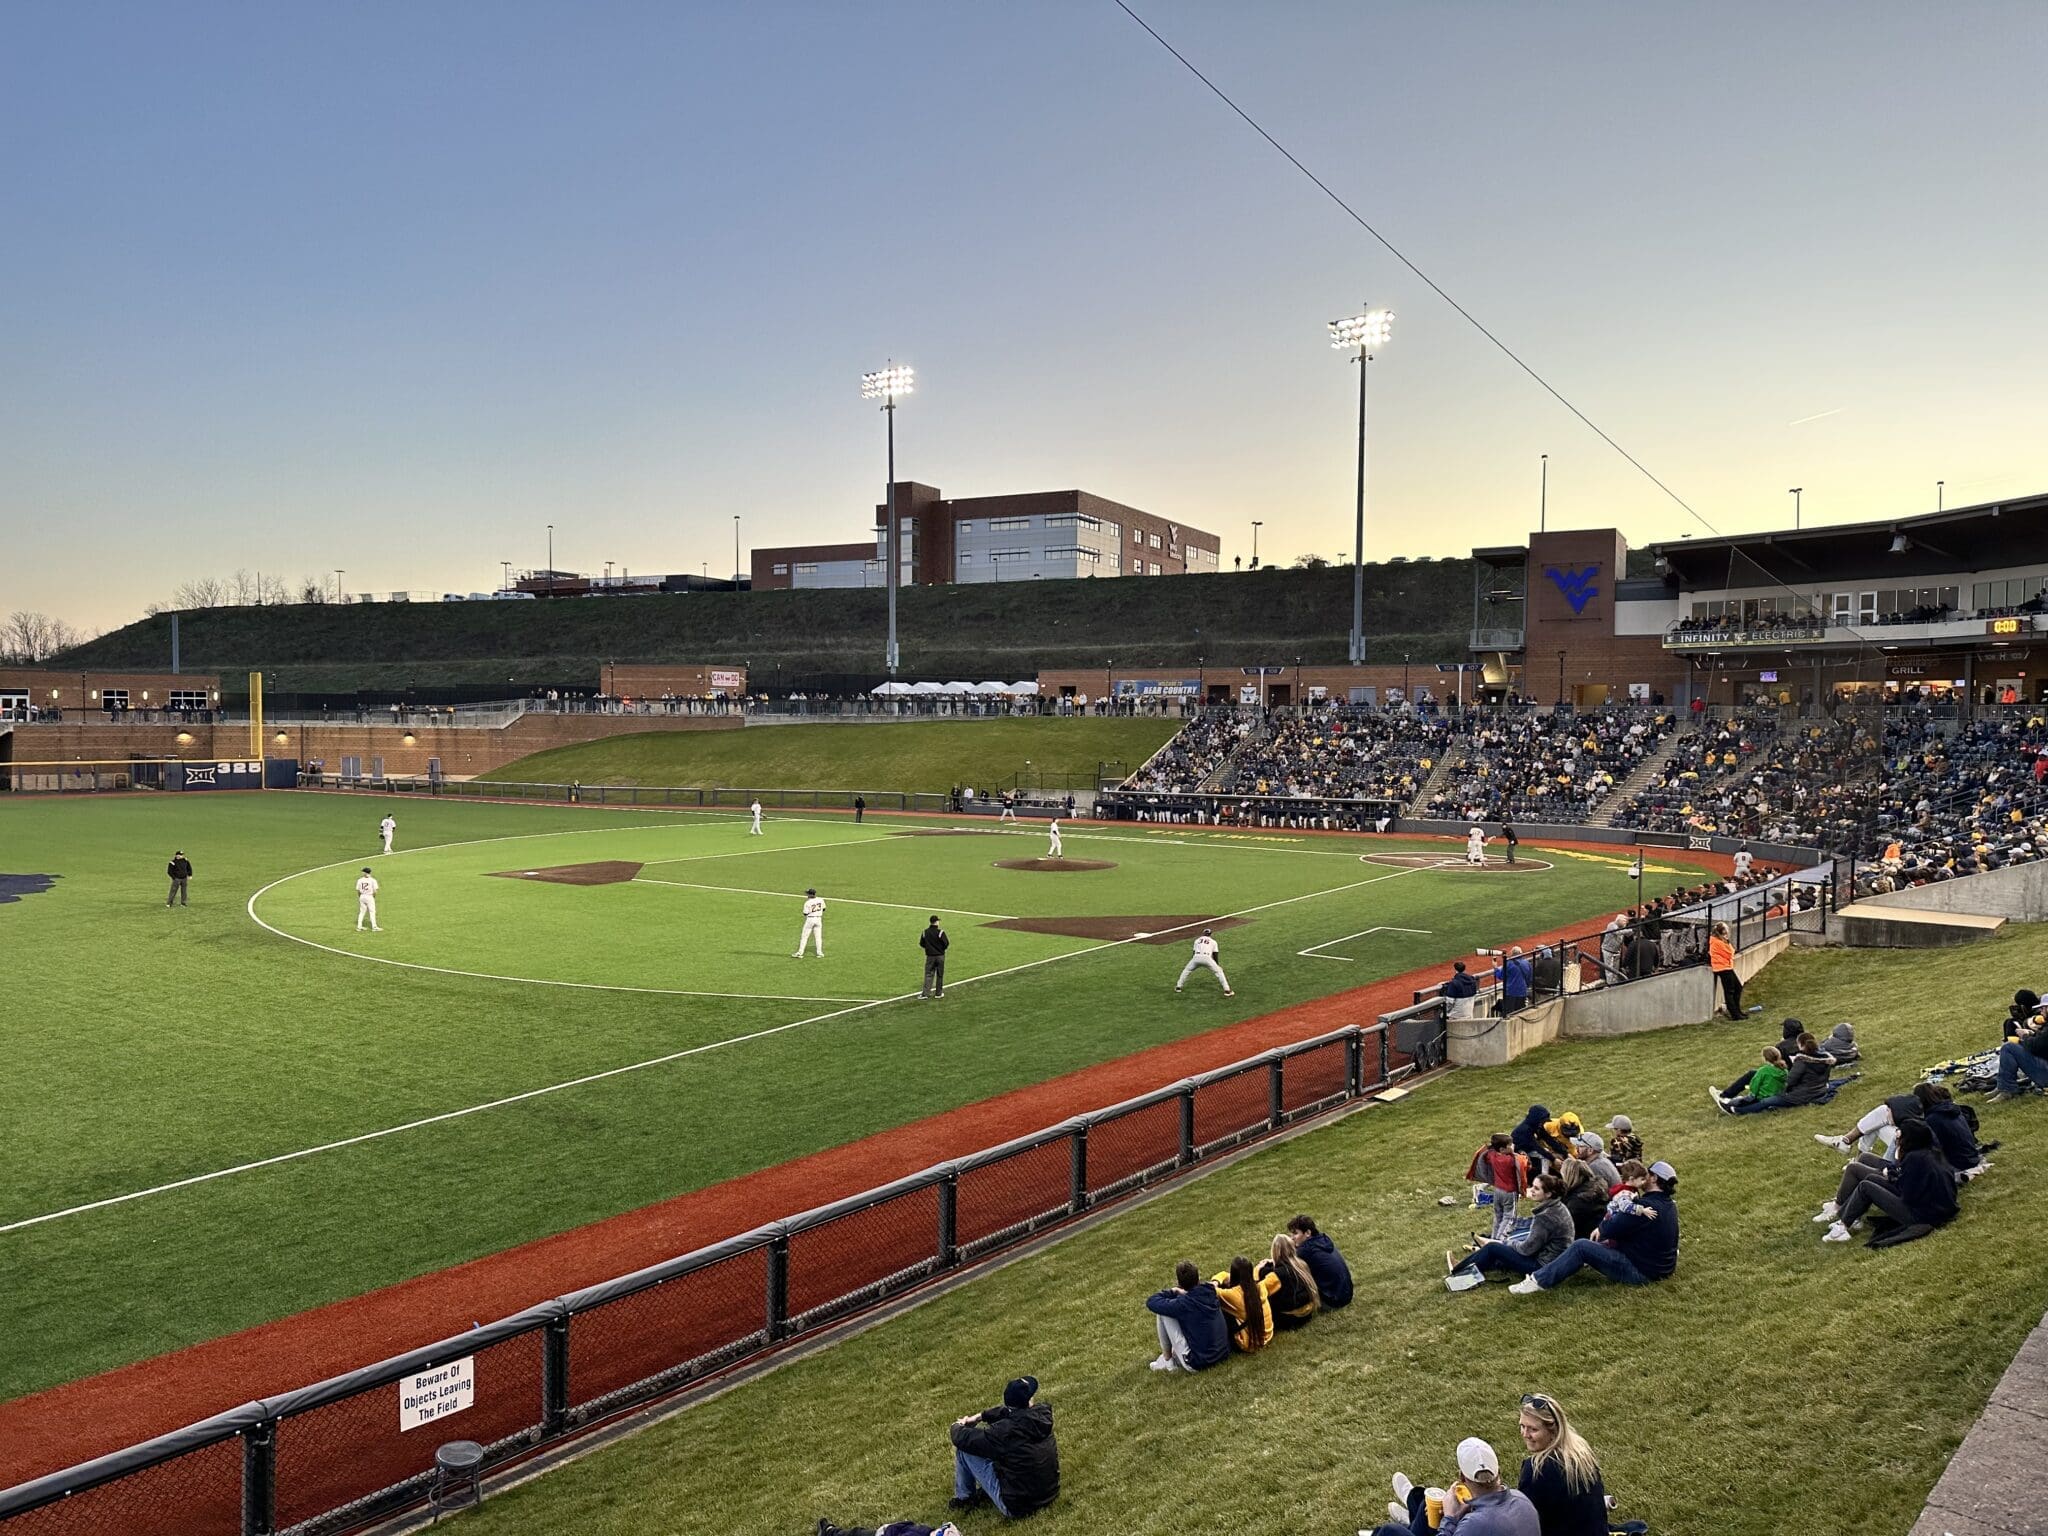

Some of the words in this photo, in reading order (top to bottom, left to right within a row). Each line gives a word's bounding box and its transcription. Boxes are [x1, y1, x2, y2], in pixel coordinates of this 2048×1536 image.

[1994, 620, 2017, 633] 0:00
[1680, 633, 1729, 643] INFINITY
[1752, 630, 1806, 640] ELECTRIC
[1891, 666, 1925, 675] GRILL
[1143, 686, 1162, 695] BEAR
[1162, 686, 1198, 695] COUNTRY
[217, 762, 262, 774] 325
[361, 882, 369, 891] 12
[811, 902, 822, 913] 23
[416, 1371, 448, 1390] Beware
[450, 1364, 460, 1378] Of
[404, 1390, 437, 1410] Objects
[440, 1378, 472, 1397] Leaving
[419, 1407, 434, 1421] The
[437, 1397, 458, 1415] Field
